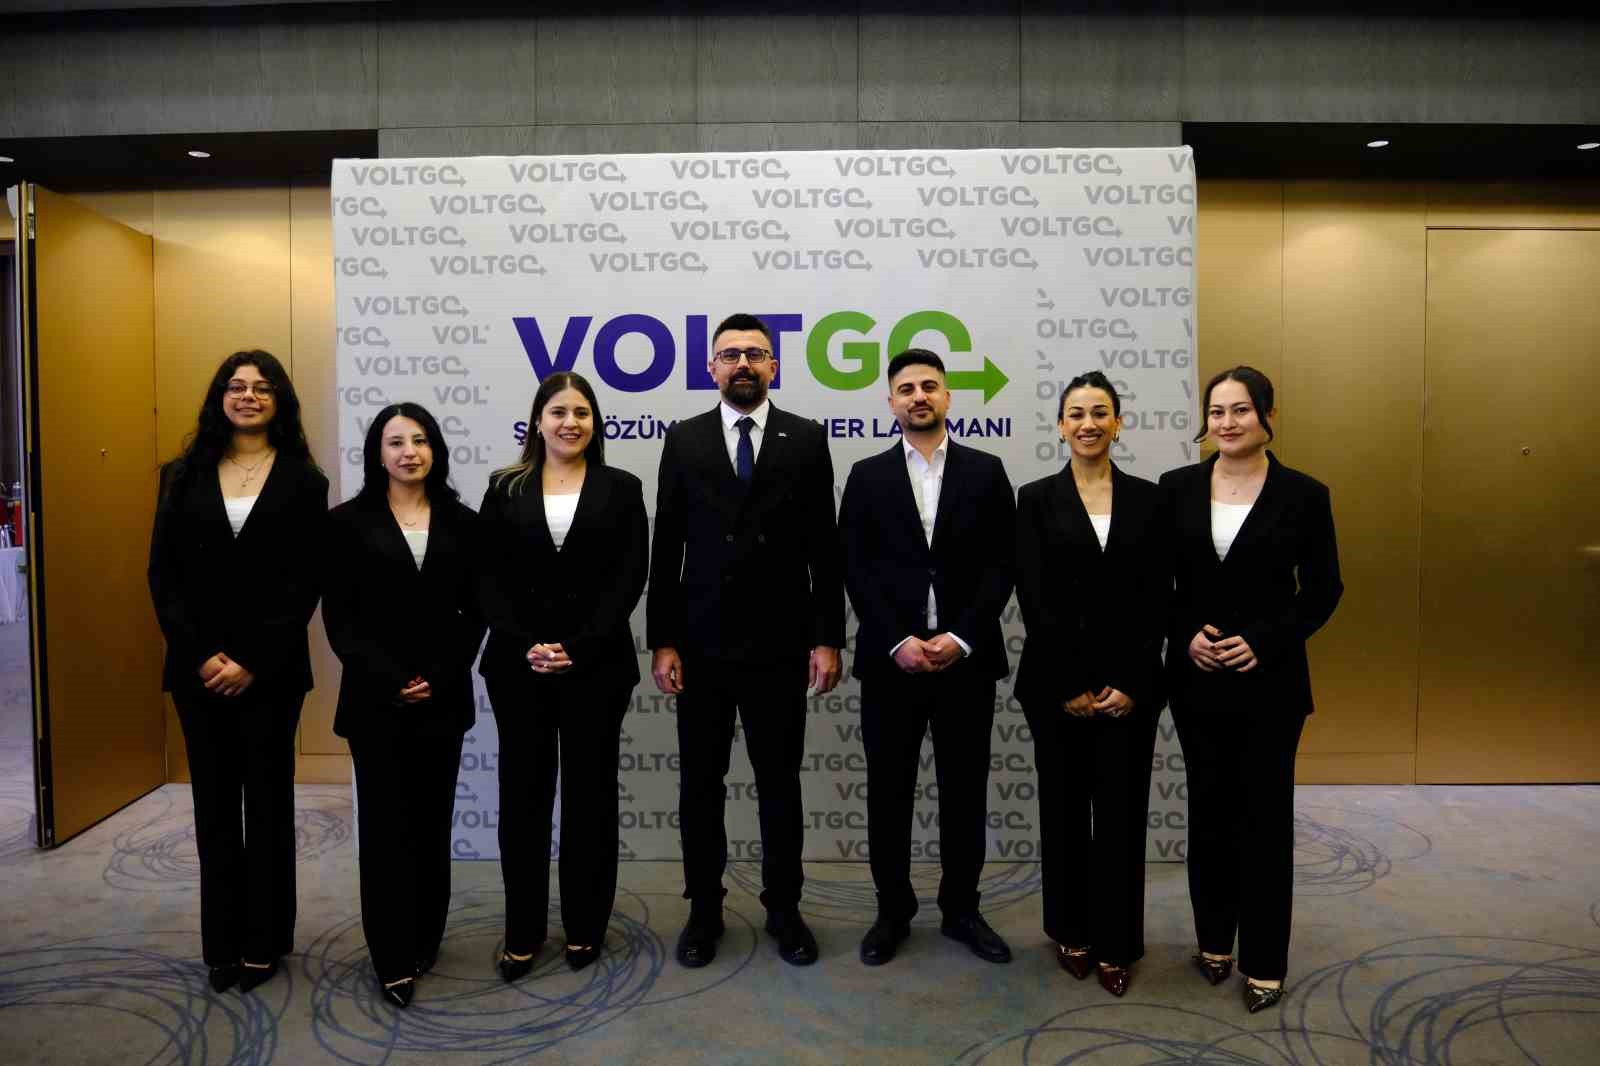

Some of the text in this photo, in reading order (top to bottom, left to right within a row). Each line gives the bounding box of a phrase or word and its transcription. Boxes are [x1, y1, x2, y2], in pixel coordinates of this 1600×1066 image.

[1101, 286, 1192, 307] VOLTG
[1037, 318, 1137, 342] OLTGO
[1100, 349, 1191, 370] VOLTG
